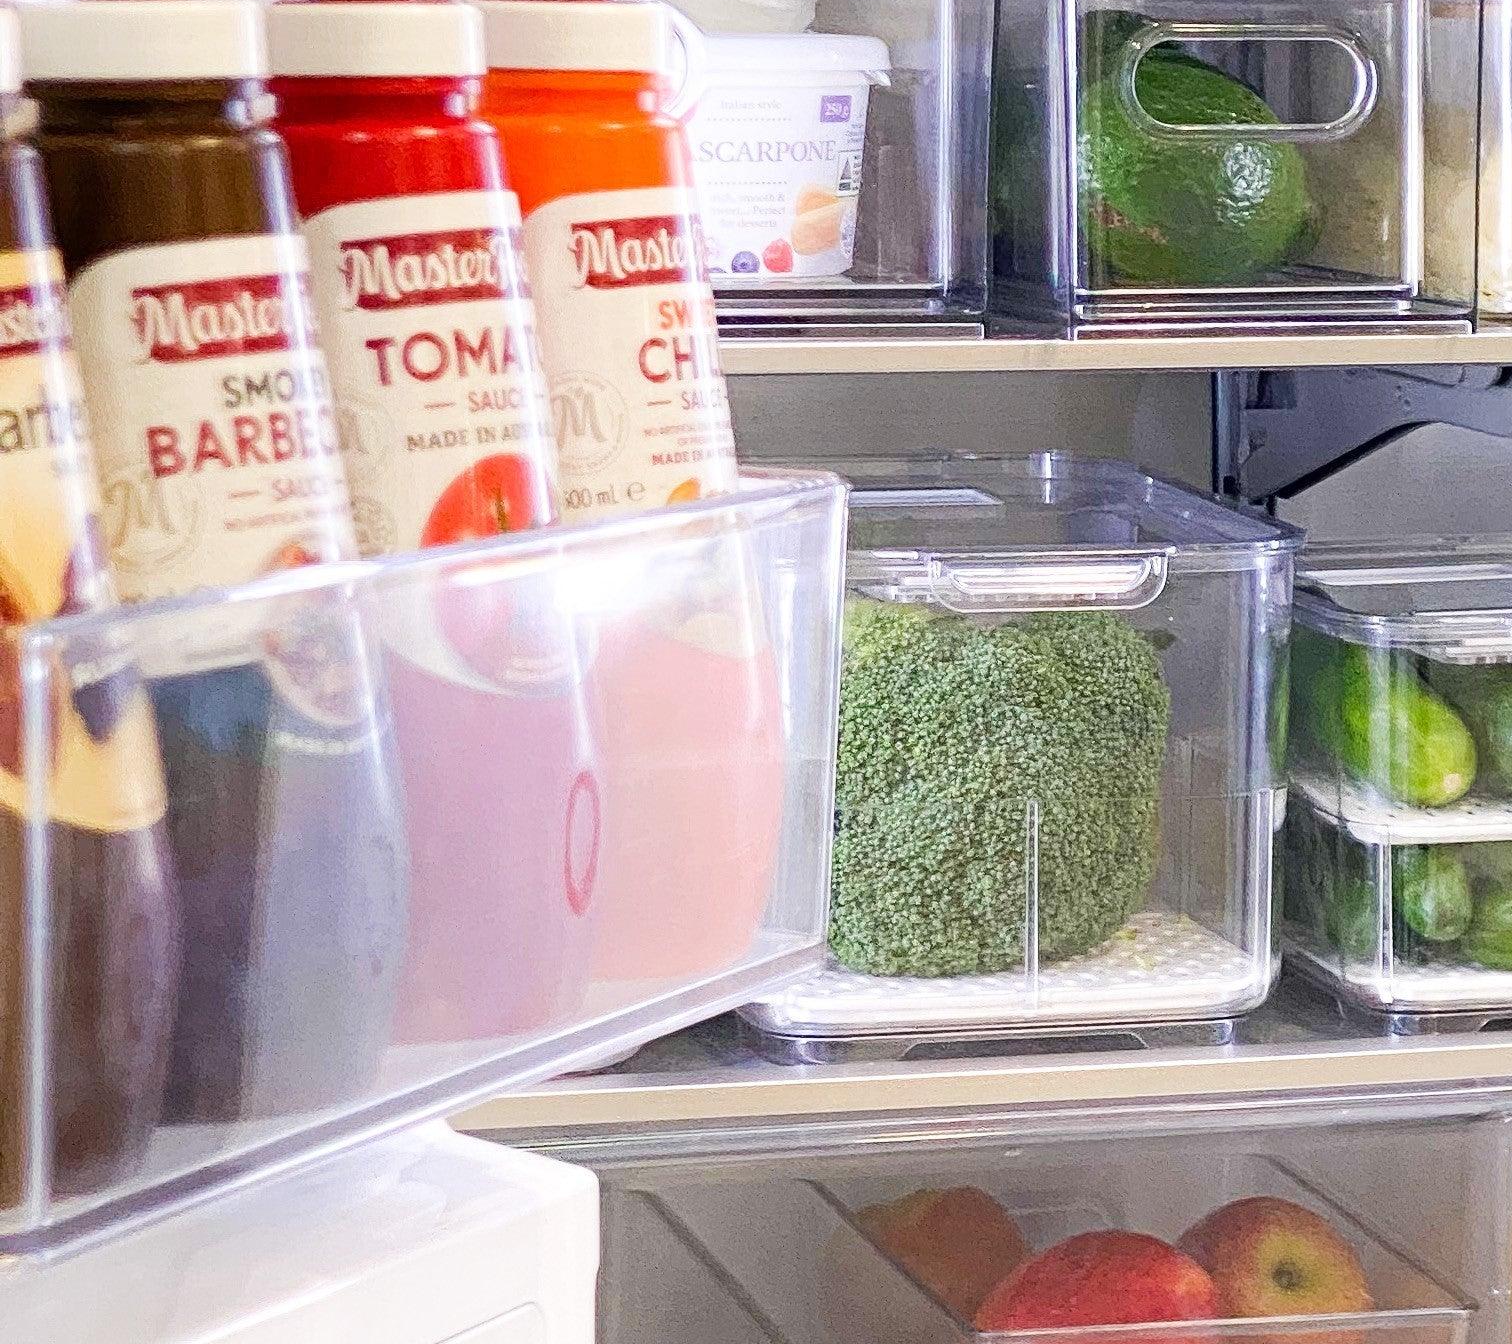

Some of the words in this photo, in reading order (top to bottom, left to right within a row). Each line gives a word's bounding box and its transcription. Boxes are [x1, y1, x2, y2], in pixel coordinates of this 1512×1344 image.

[694, 140, 836, 163] SCARPONE
[223, 368, 327, 410] SMO
[468, 390, 528, 414] SAUC
[146, 406, 334, 479] BARBE
